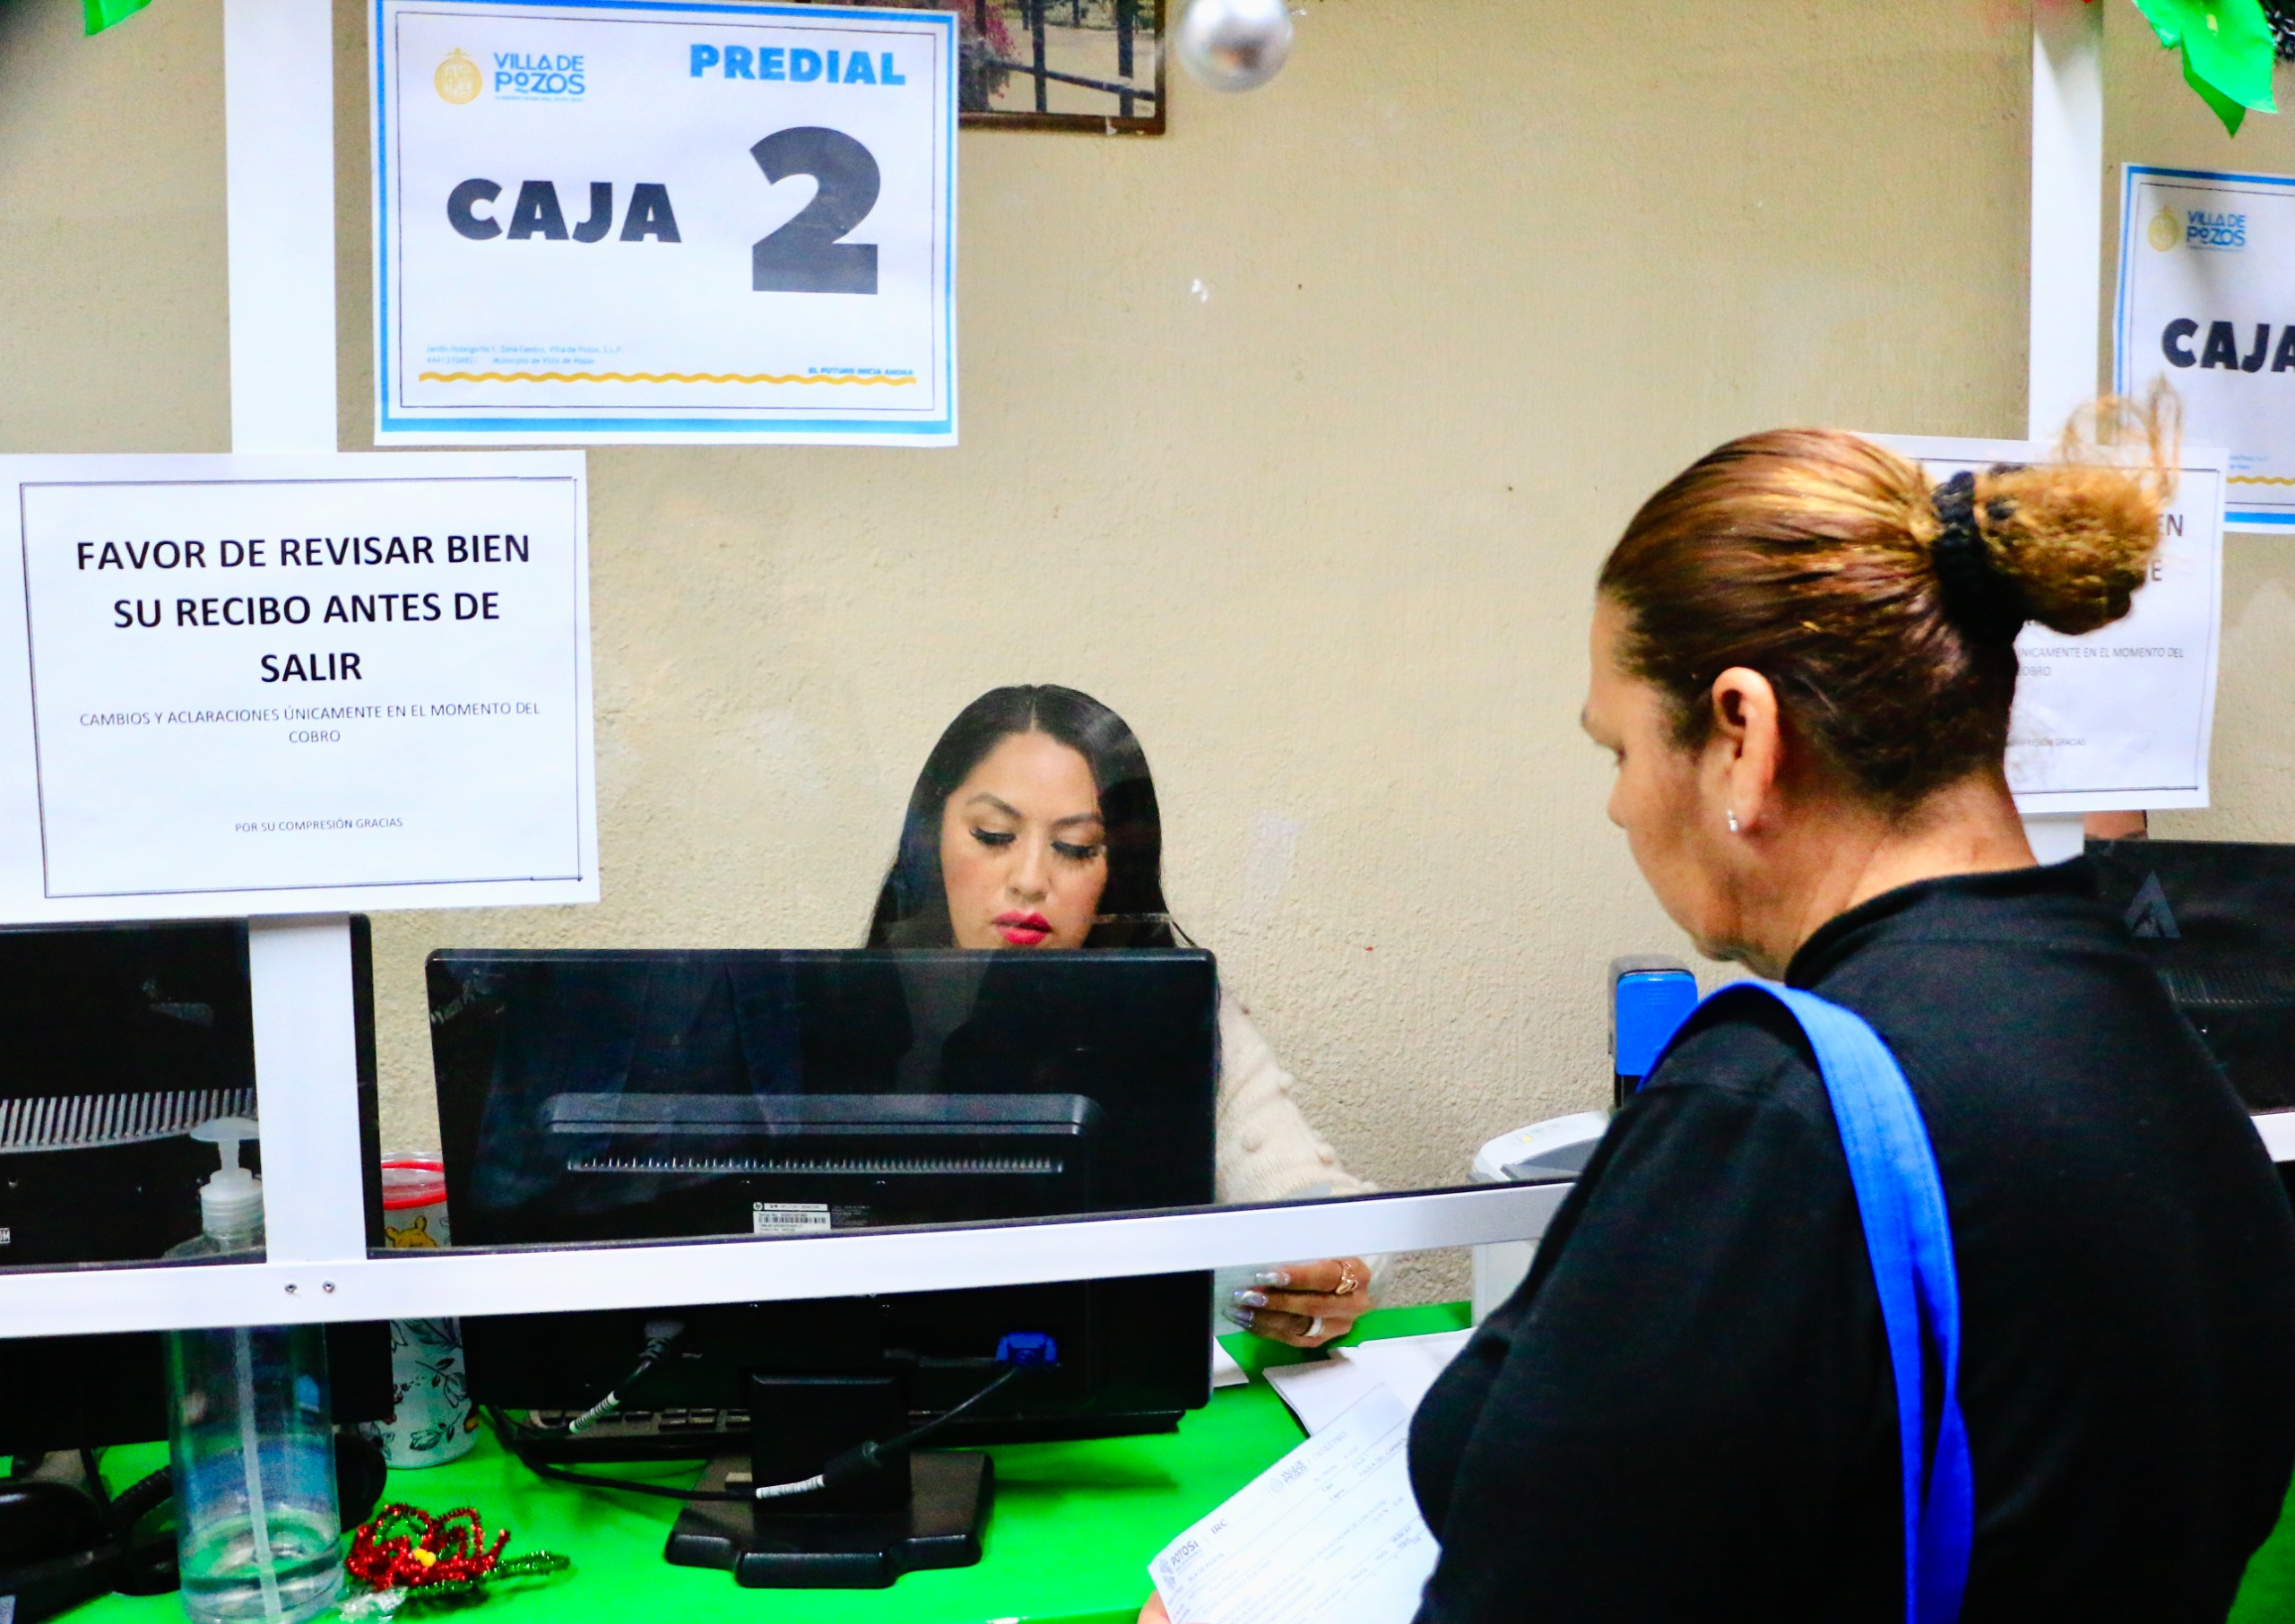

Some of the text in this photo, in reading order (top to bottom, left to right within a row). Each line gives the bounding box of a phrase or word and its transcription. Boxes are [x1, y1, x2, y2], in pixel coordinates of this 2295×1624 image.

[494, 52, 585, 72] VILLA DE
[689, 43, 906, 86] PREDIAL
[446, 177, 682, 245] CAJA
[749, 125, 882, 296] 2
[2187, 211, 2247, 228] VILLA DE
[2161, 316, 2295, 373] CAJA
[77, 533, 531, 570] FAVOR DE REVISAR BIEN
[114, 592, 500, 628] SU RECIBO ANTES DE
[2083, 647, 2097, 658] EN
[2100, 647, 2110, 658] EL
[2112, 646, 2165, 658] MOMENTO
[2168, 646, 2185, 658] DEL
[260, 652, 362, 684] SALIR
[80, 702, 541, 727] CAMBIOS Y ACLARACIONES ÚNICAMENTE EN EL MOMENTO DEL
[289, 730, 341, 745] COBRO
[235, 817, 403, 834] POR SU COMPRESIÓN GRACIAS
[1210, 1518, 1228, 1534] IRC
